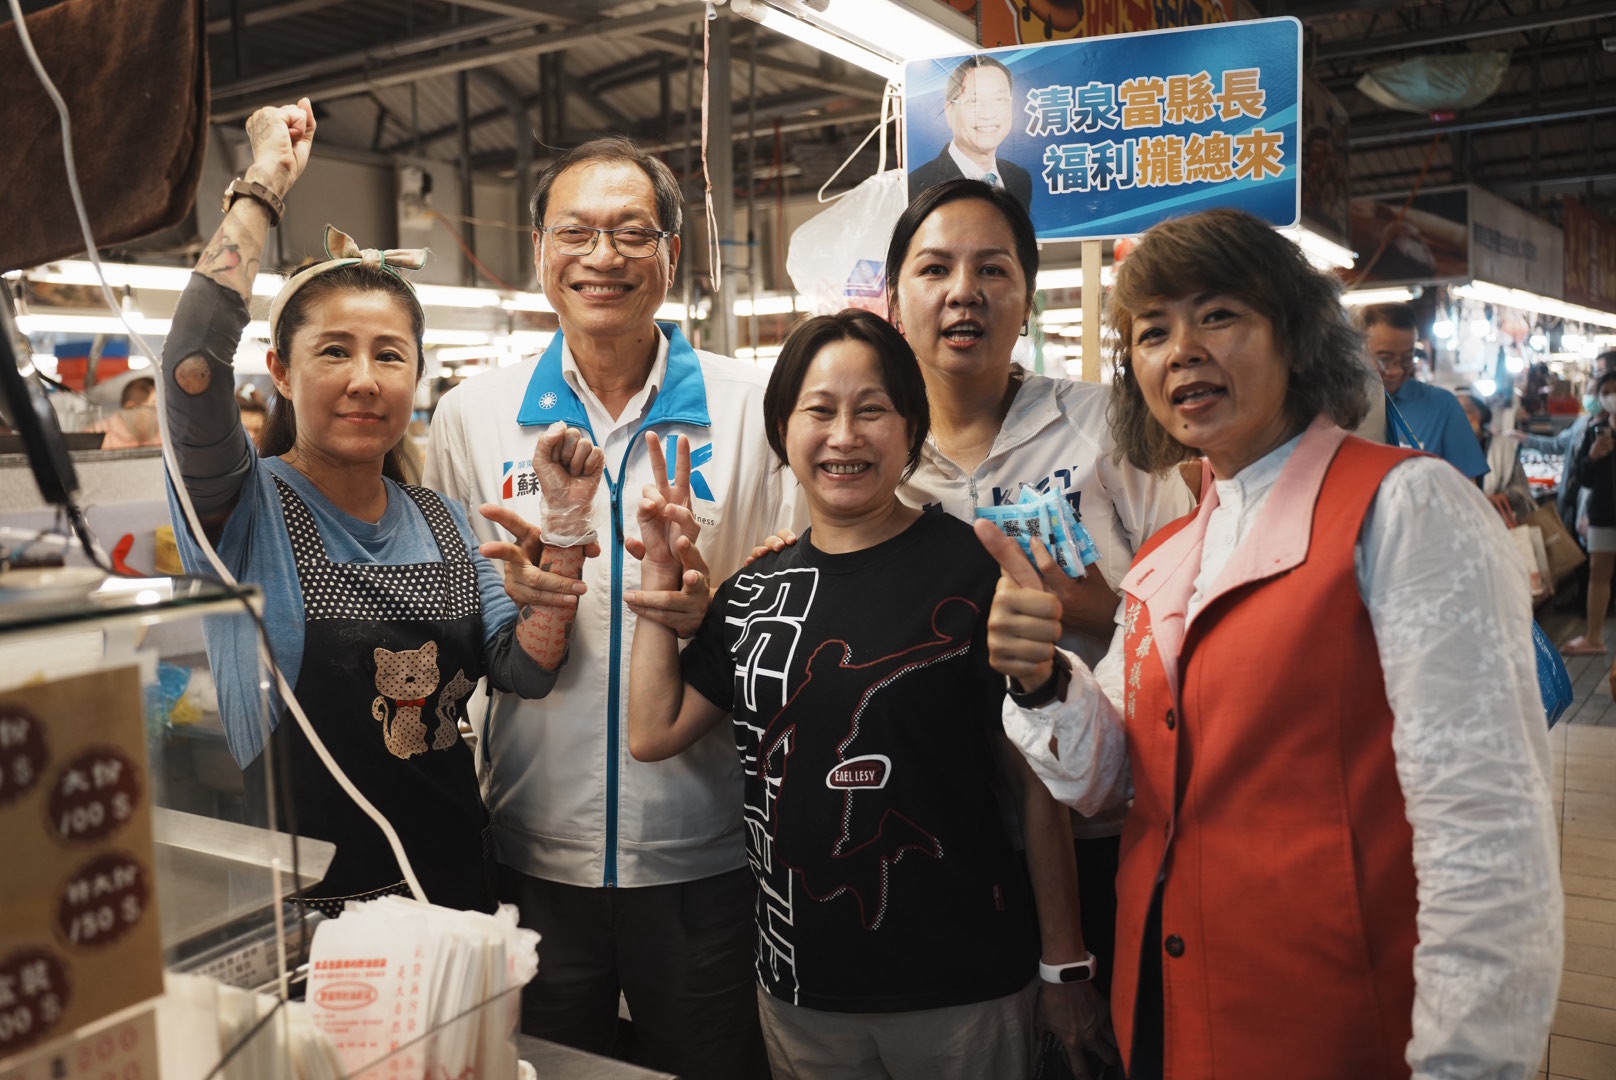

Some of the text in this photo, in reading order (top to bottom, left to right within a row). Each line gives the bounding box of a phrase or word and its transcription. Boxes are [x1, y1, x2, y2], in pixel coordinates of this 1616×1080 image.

[1025, 67, 1266, 137] 清泉當縣長
[1042, 128, 1285, 194] 福利攏總來
[516, 472, 541, 496] 蘇
[855, 770, 875, 782] LESY
